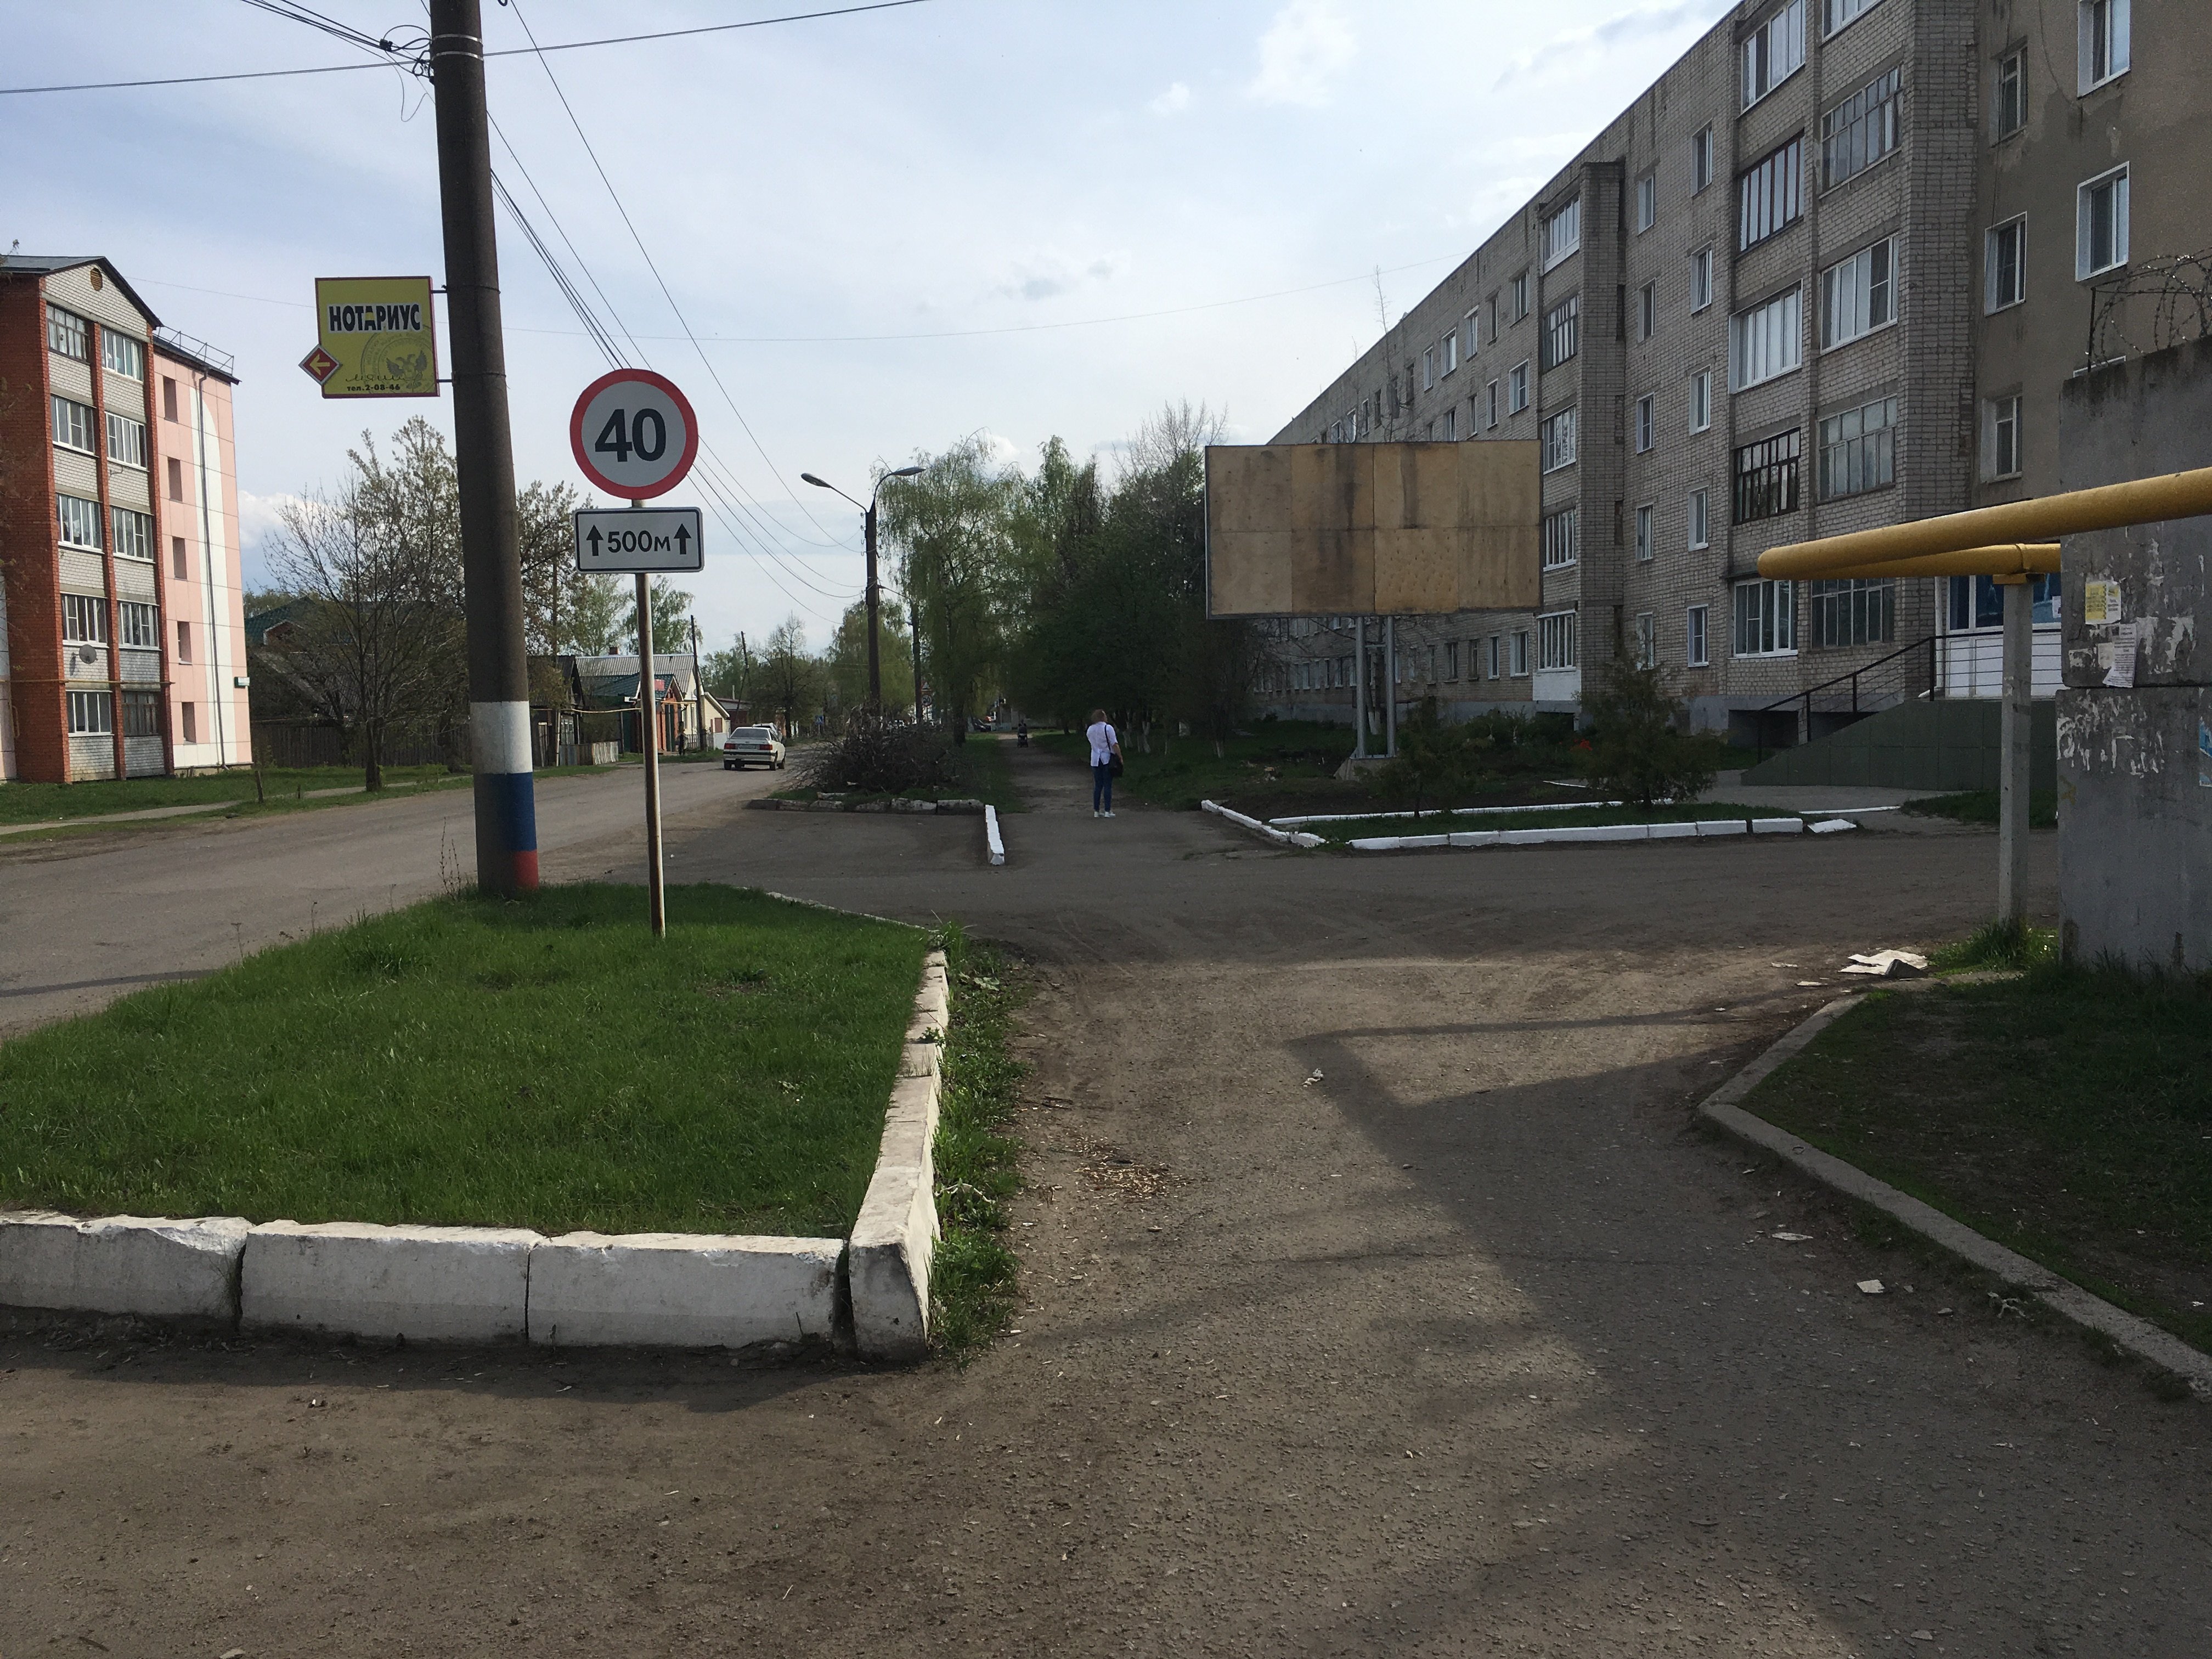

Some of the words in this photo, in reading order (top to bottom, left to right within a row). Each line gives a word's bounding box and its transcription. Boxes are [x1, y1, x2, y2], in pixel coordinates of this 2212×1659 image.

[329, 304, 421, 331] НОТАРИУС
[595, 408, 667, 462] 40
[607, 531, 671, 552] 500м
